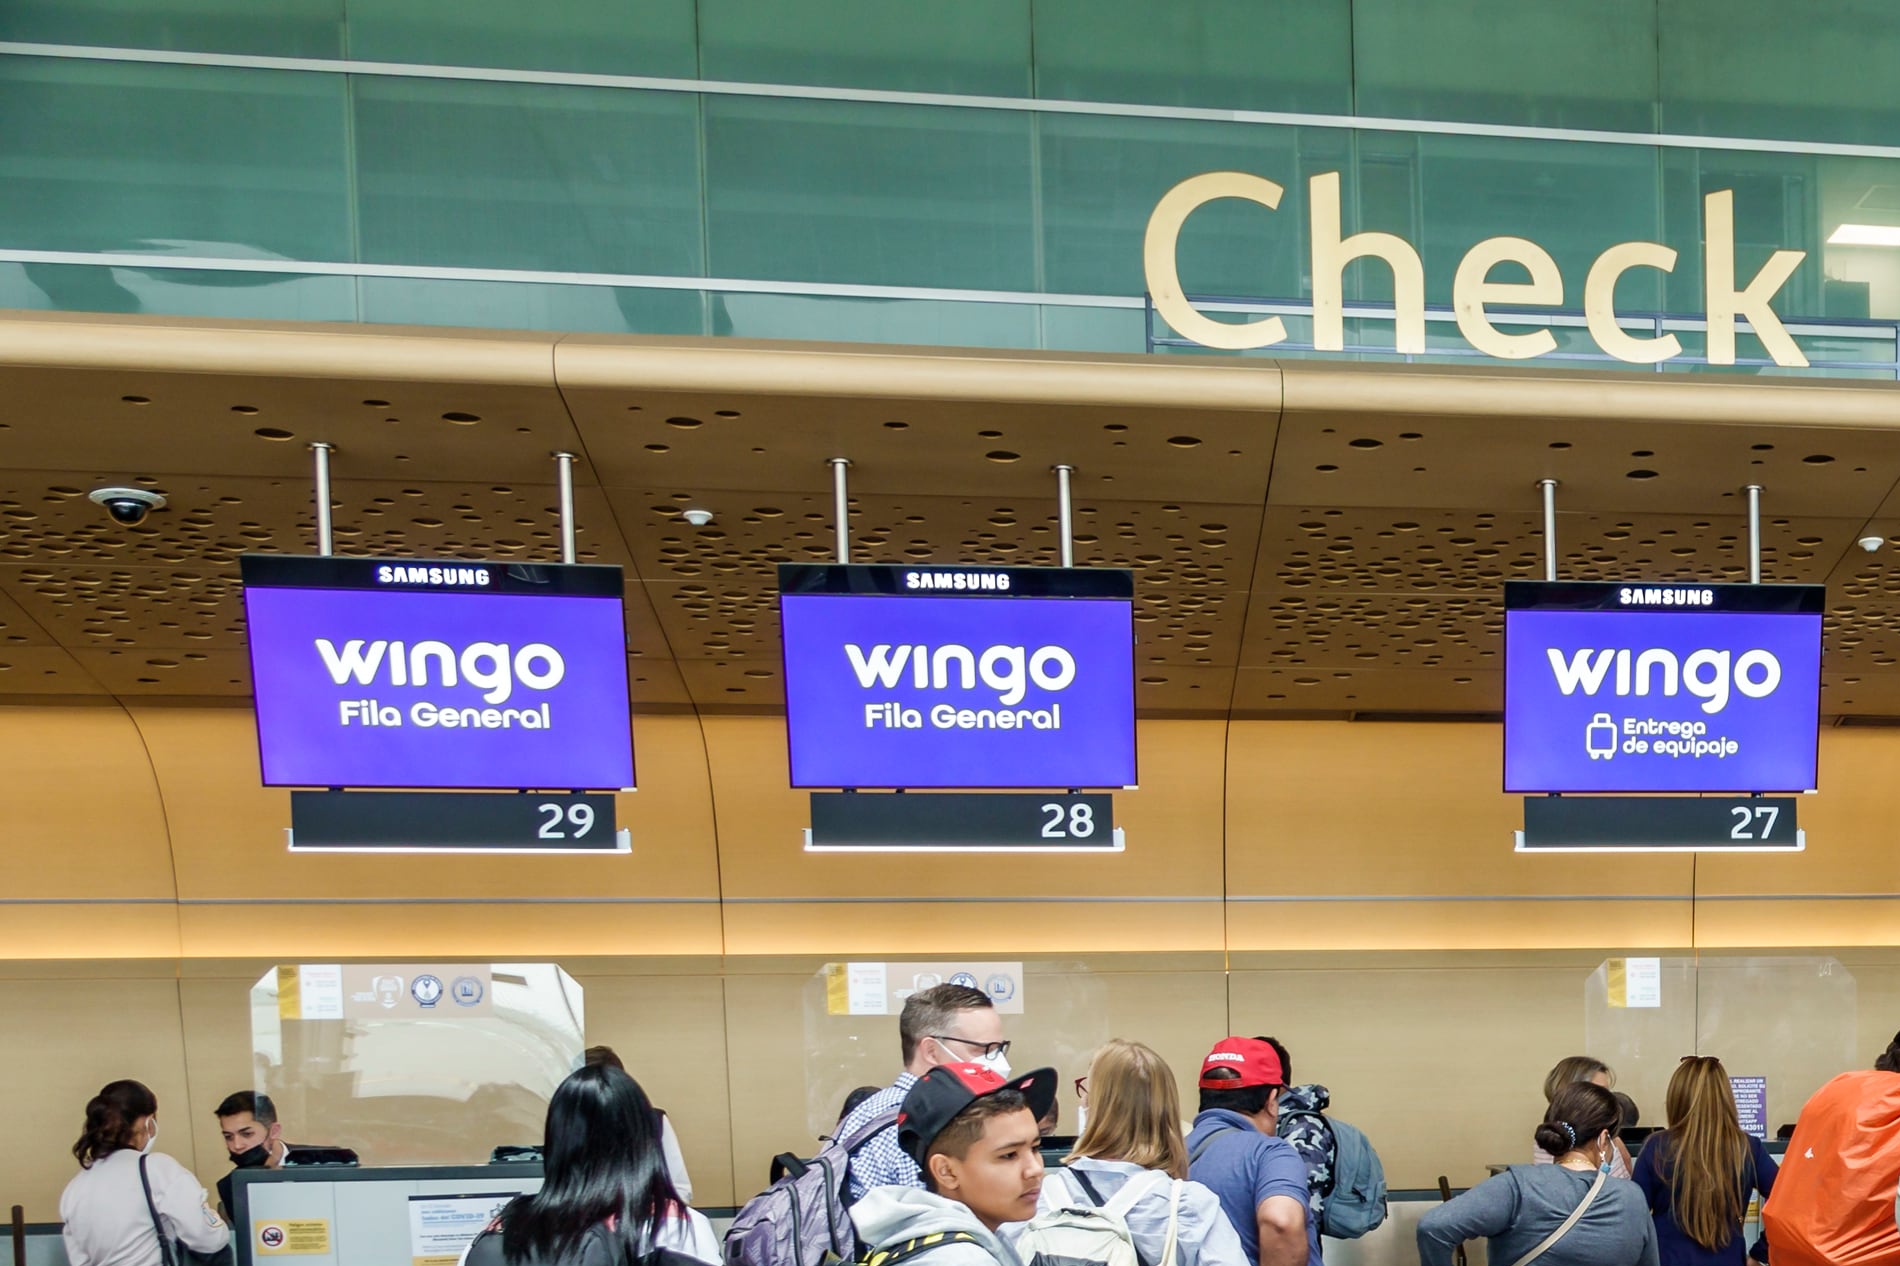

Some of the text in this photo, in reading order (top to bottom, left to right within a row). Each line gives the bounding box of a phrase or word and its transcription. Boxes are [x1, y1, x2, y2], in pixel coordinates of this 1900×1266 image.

[1142, 170, 1811, 369] Check
[378, 566, 490, 586] SAMSUNG
[906, 572, 1010, 590] SAMSUNG
[1620, 587, 1713, 606] SAMSUNG
[314, 637, 566, 704] wingo
[844, 643, 1076, 704] wingo
[1546, 648, 1782, 713] wingo
[339, 699, 551, 730] Fila General
[864, 702, 1061, 730] Fila General
[1623, 717, 1707, 736] Entrega
[1622, 737, 1739, 759] de equipaje
[537, 803, 595, 839] 29
[1040, 803, 1095, 838] 28
[1730, 806, 1780, 839] 27
